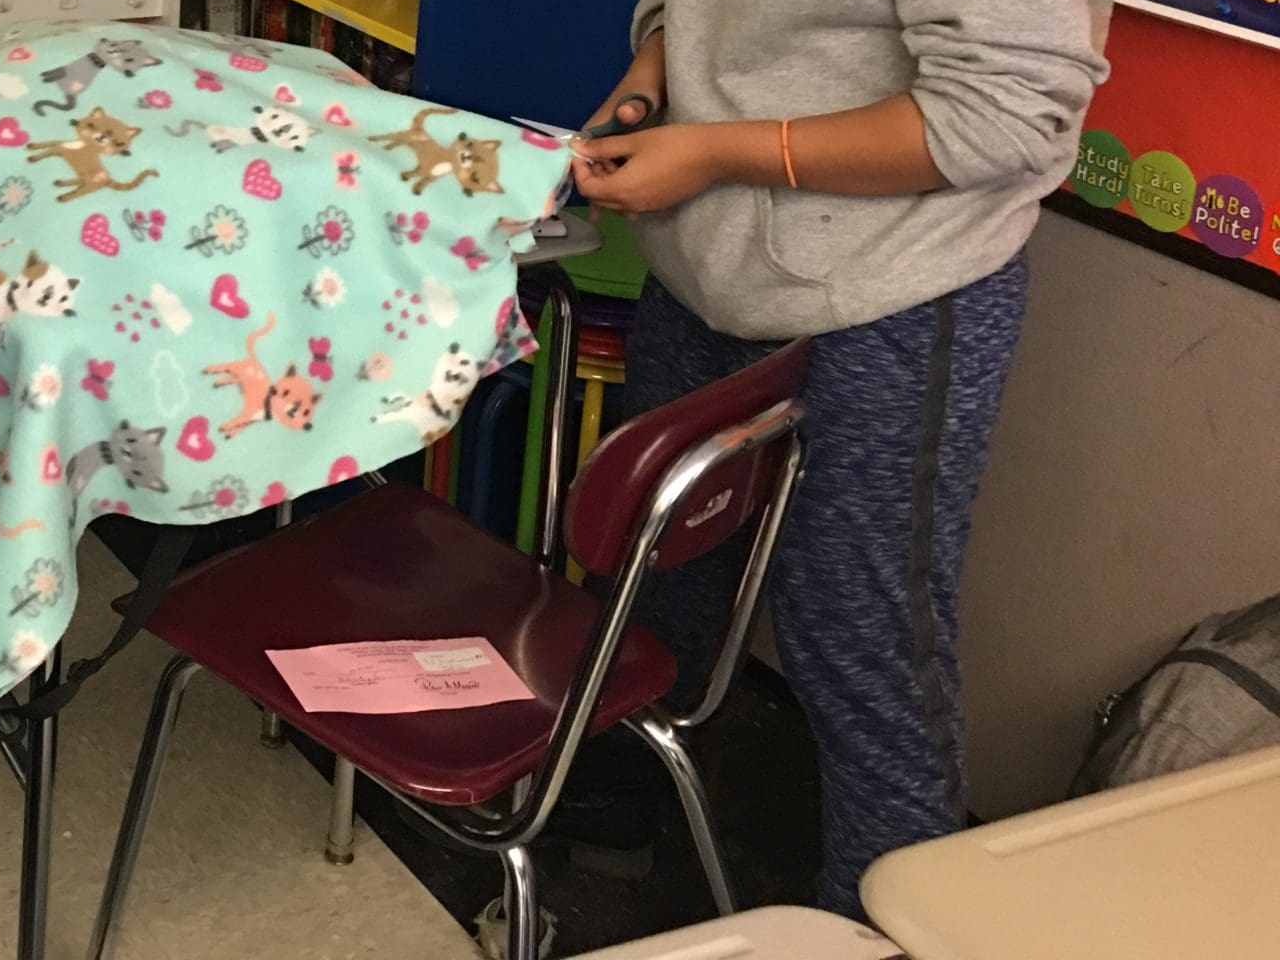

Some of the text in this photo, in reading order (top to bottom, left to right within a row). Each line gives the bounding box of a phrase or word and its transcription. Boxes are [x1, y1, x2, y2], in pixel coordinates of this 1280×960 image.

[1078, 144, 1129, 179] Study
[1076, 163, 1123, 197] Hard!
[1143, 164, 1182, 194] Take
[1133, 183, 1187, 220] Turns!
[1227, 196, 1251, 219] Be
[1195, 206, 1260, 245] Polite!
